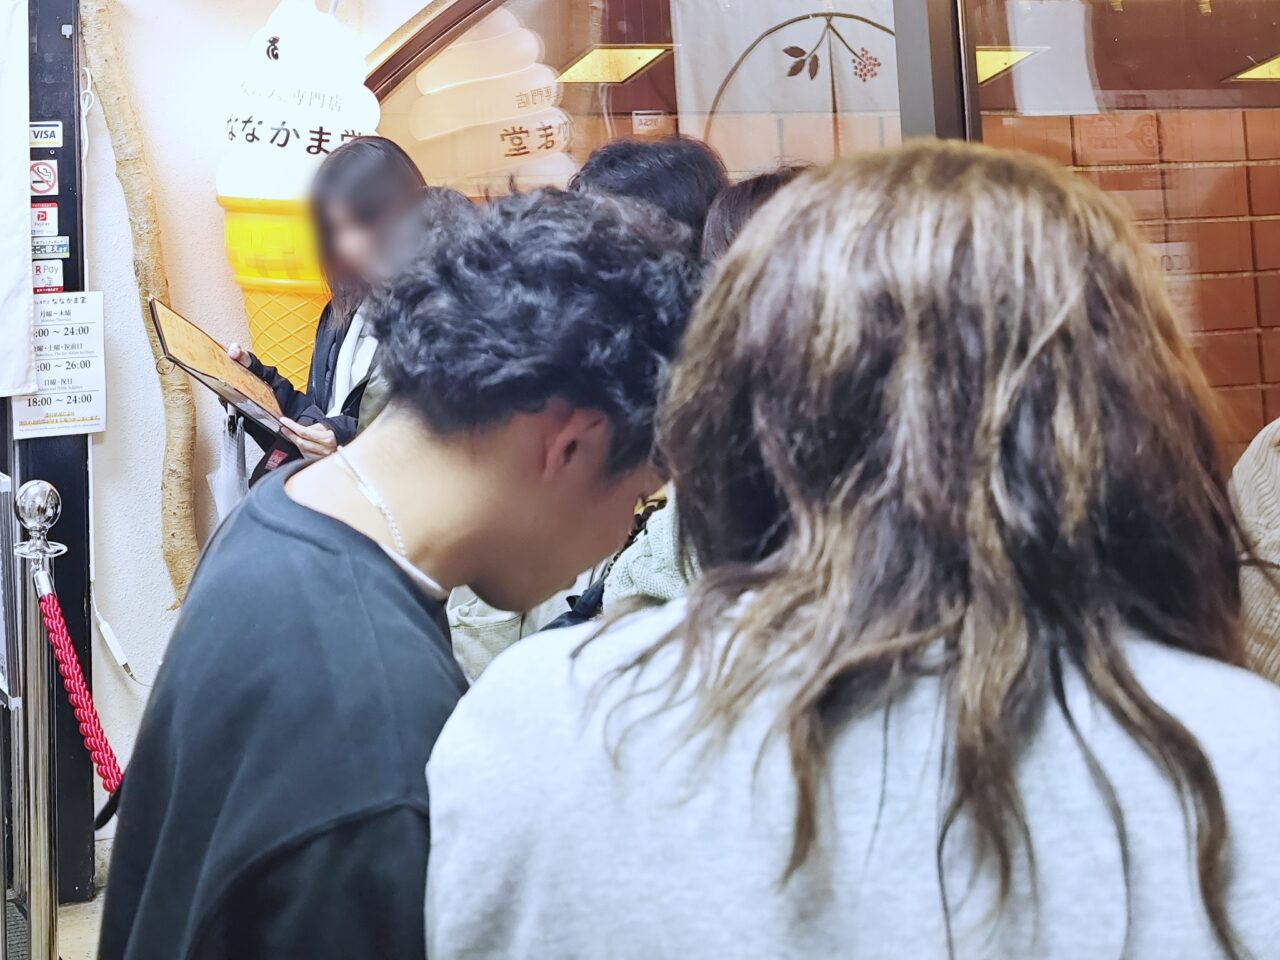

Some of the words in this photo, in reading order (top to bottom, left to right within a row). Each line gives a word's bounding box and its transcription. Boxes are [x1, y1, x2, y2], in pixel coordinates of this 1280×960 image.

[32, 129, 56, 140] VISA
[63, 326, 89, 336] 24:00
[65, 360, 91, 370] 26:00
[27, 397, 52, 407] 18:00
[66, 394, 92, 404] 24:00
